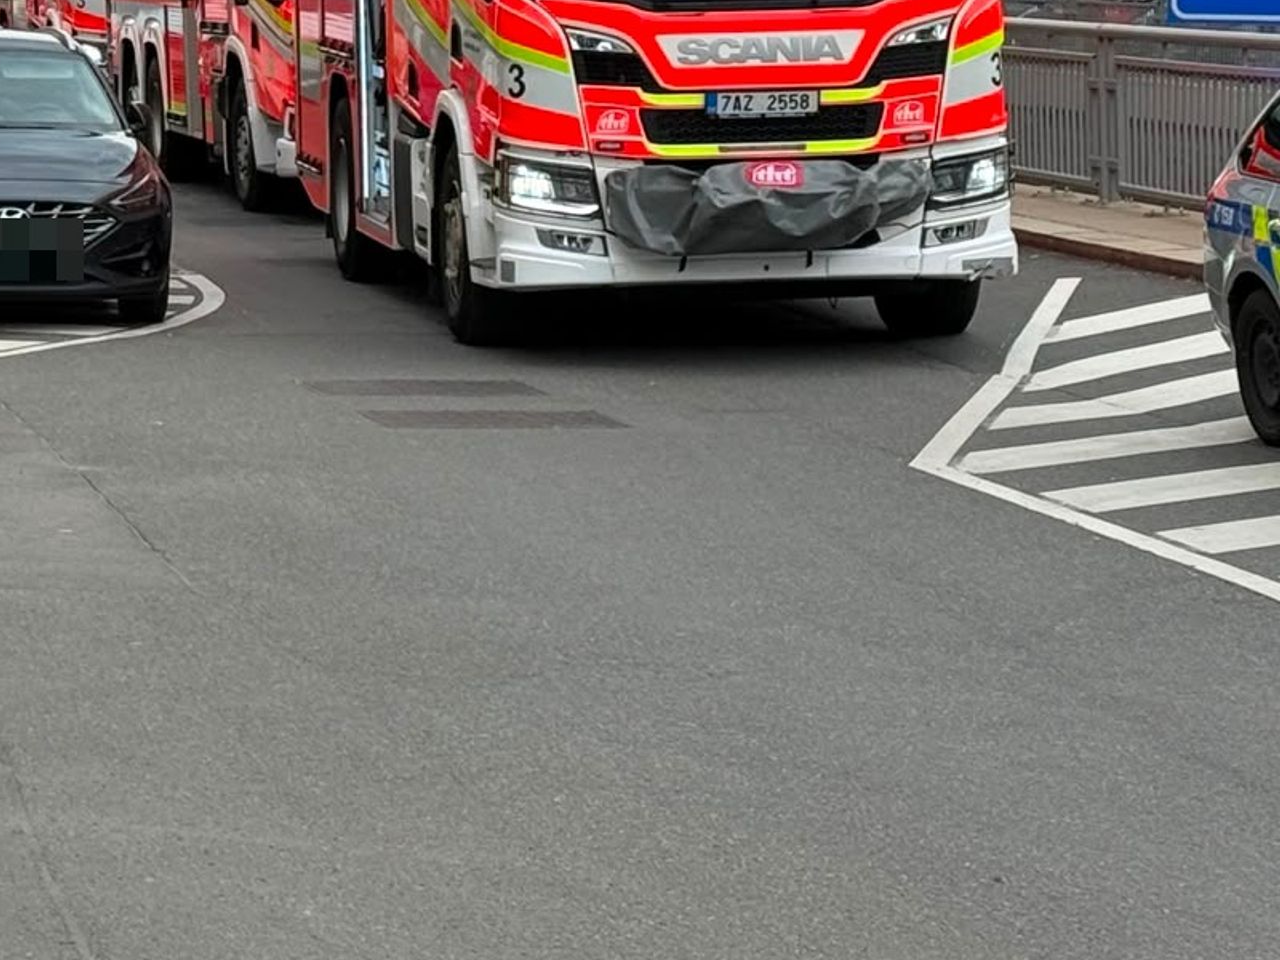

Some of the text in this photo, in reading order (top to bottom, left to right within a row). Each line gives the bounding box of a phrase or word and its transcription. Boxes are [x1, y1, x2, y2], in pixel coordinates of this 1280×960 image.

[677, 34, 844, 65] SCANIA
[508, 63, 526, 98] 3
[721, 93, 810, 112] 7AZ 2558
